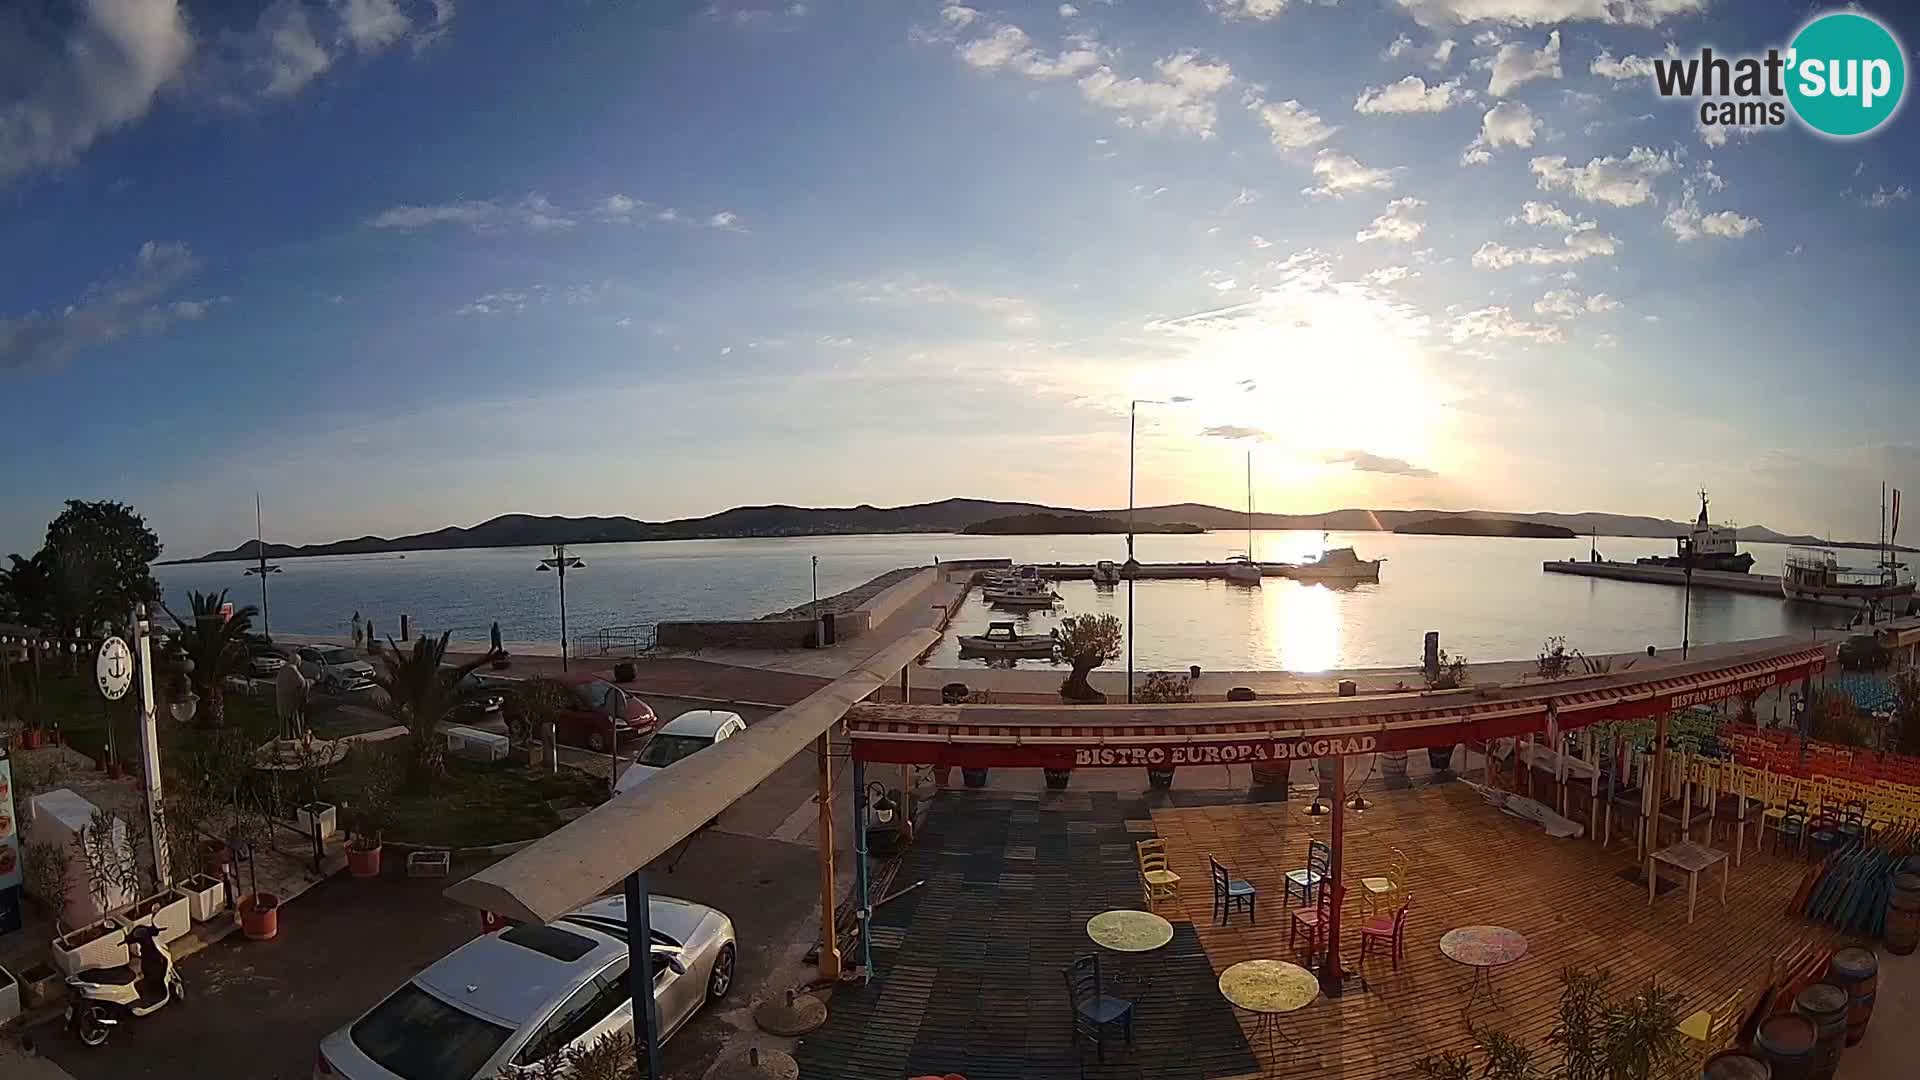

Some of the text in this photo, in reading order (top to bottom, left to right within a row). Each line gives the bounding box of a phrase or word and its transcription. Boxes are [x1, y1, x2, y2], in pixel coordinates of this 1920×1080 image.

[1076, 735, 1378, 766] BISTRO EUROPA BIOGRAD
